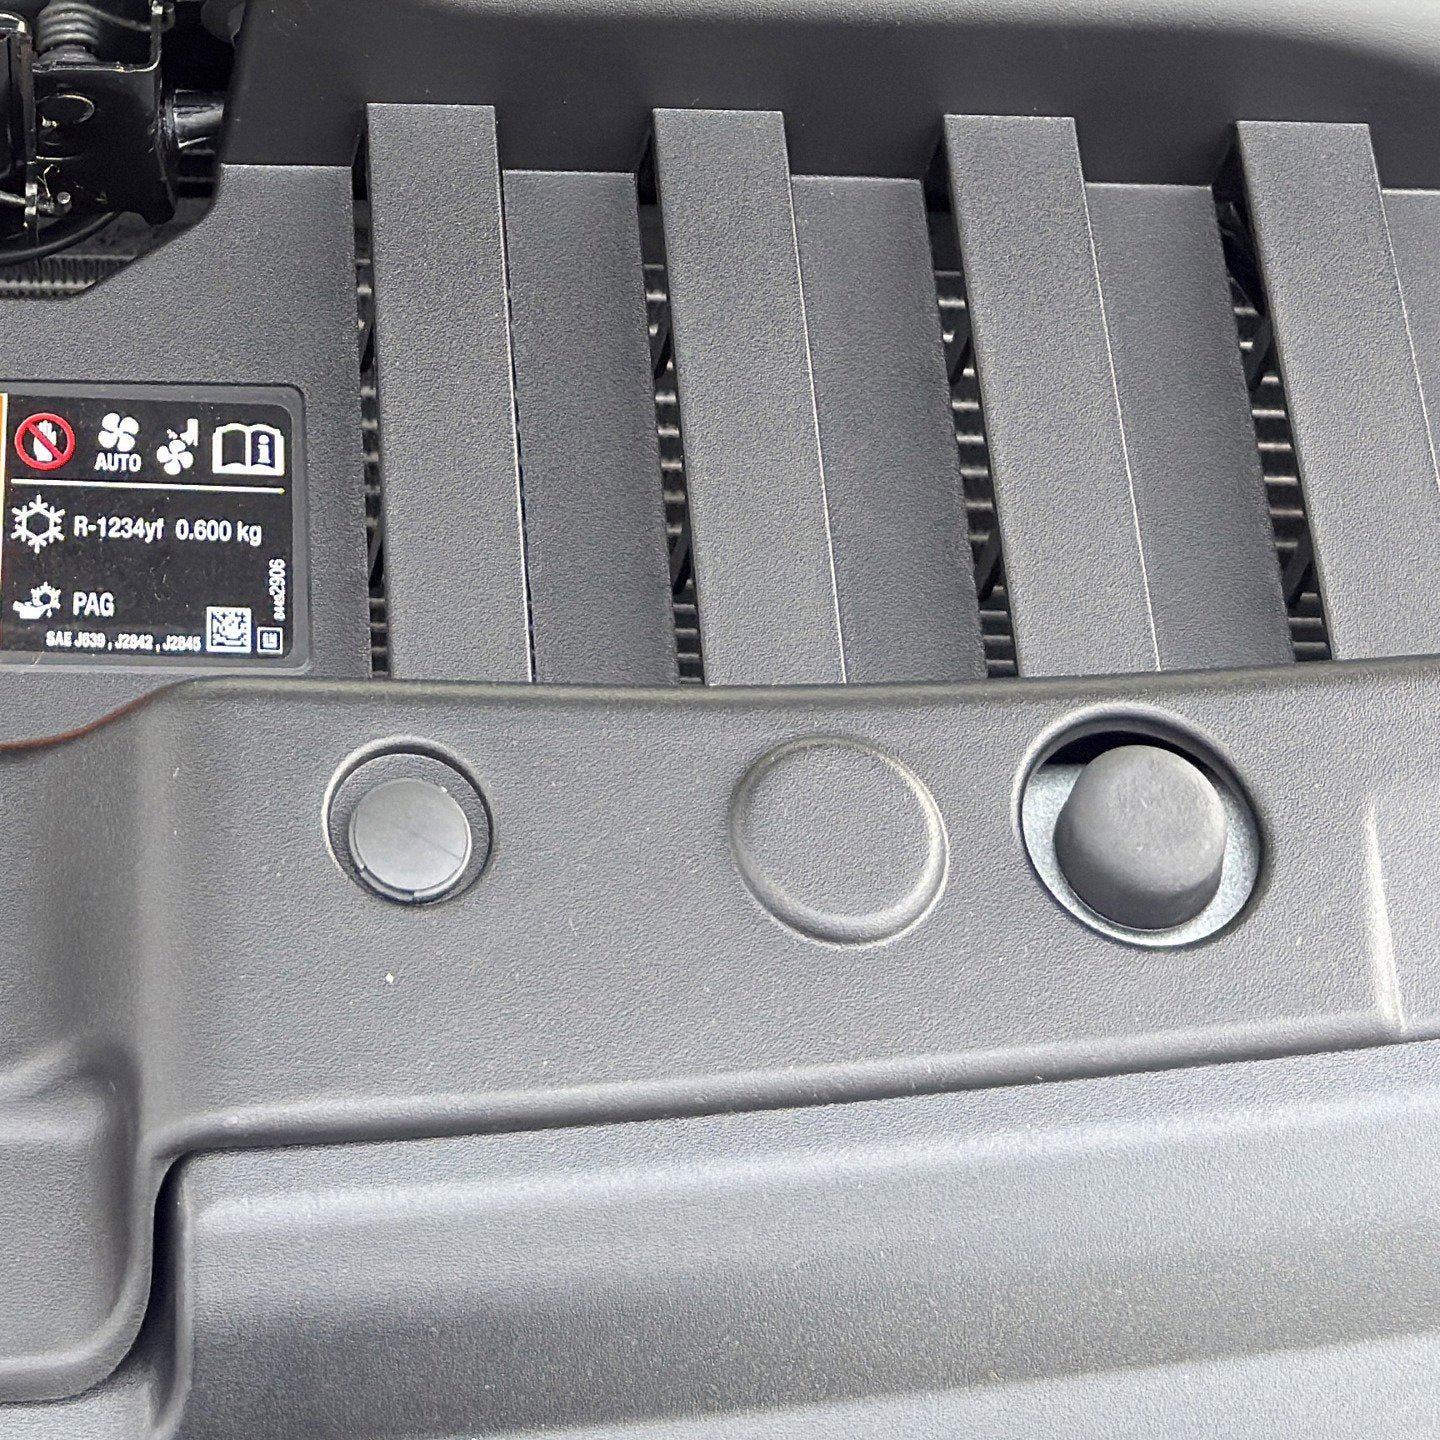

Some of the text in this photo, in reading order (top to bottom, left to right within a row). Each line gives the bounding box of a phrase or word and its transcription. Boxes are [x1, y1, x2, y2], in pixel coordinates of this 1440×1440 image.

[94, 452, 142, 472] AUTO
[73, 515, 262, 547] R-1234yf 0.600 kg
[73, 591, 114, 617] PAG
[46, 630, 71, 647] SAE
